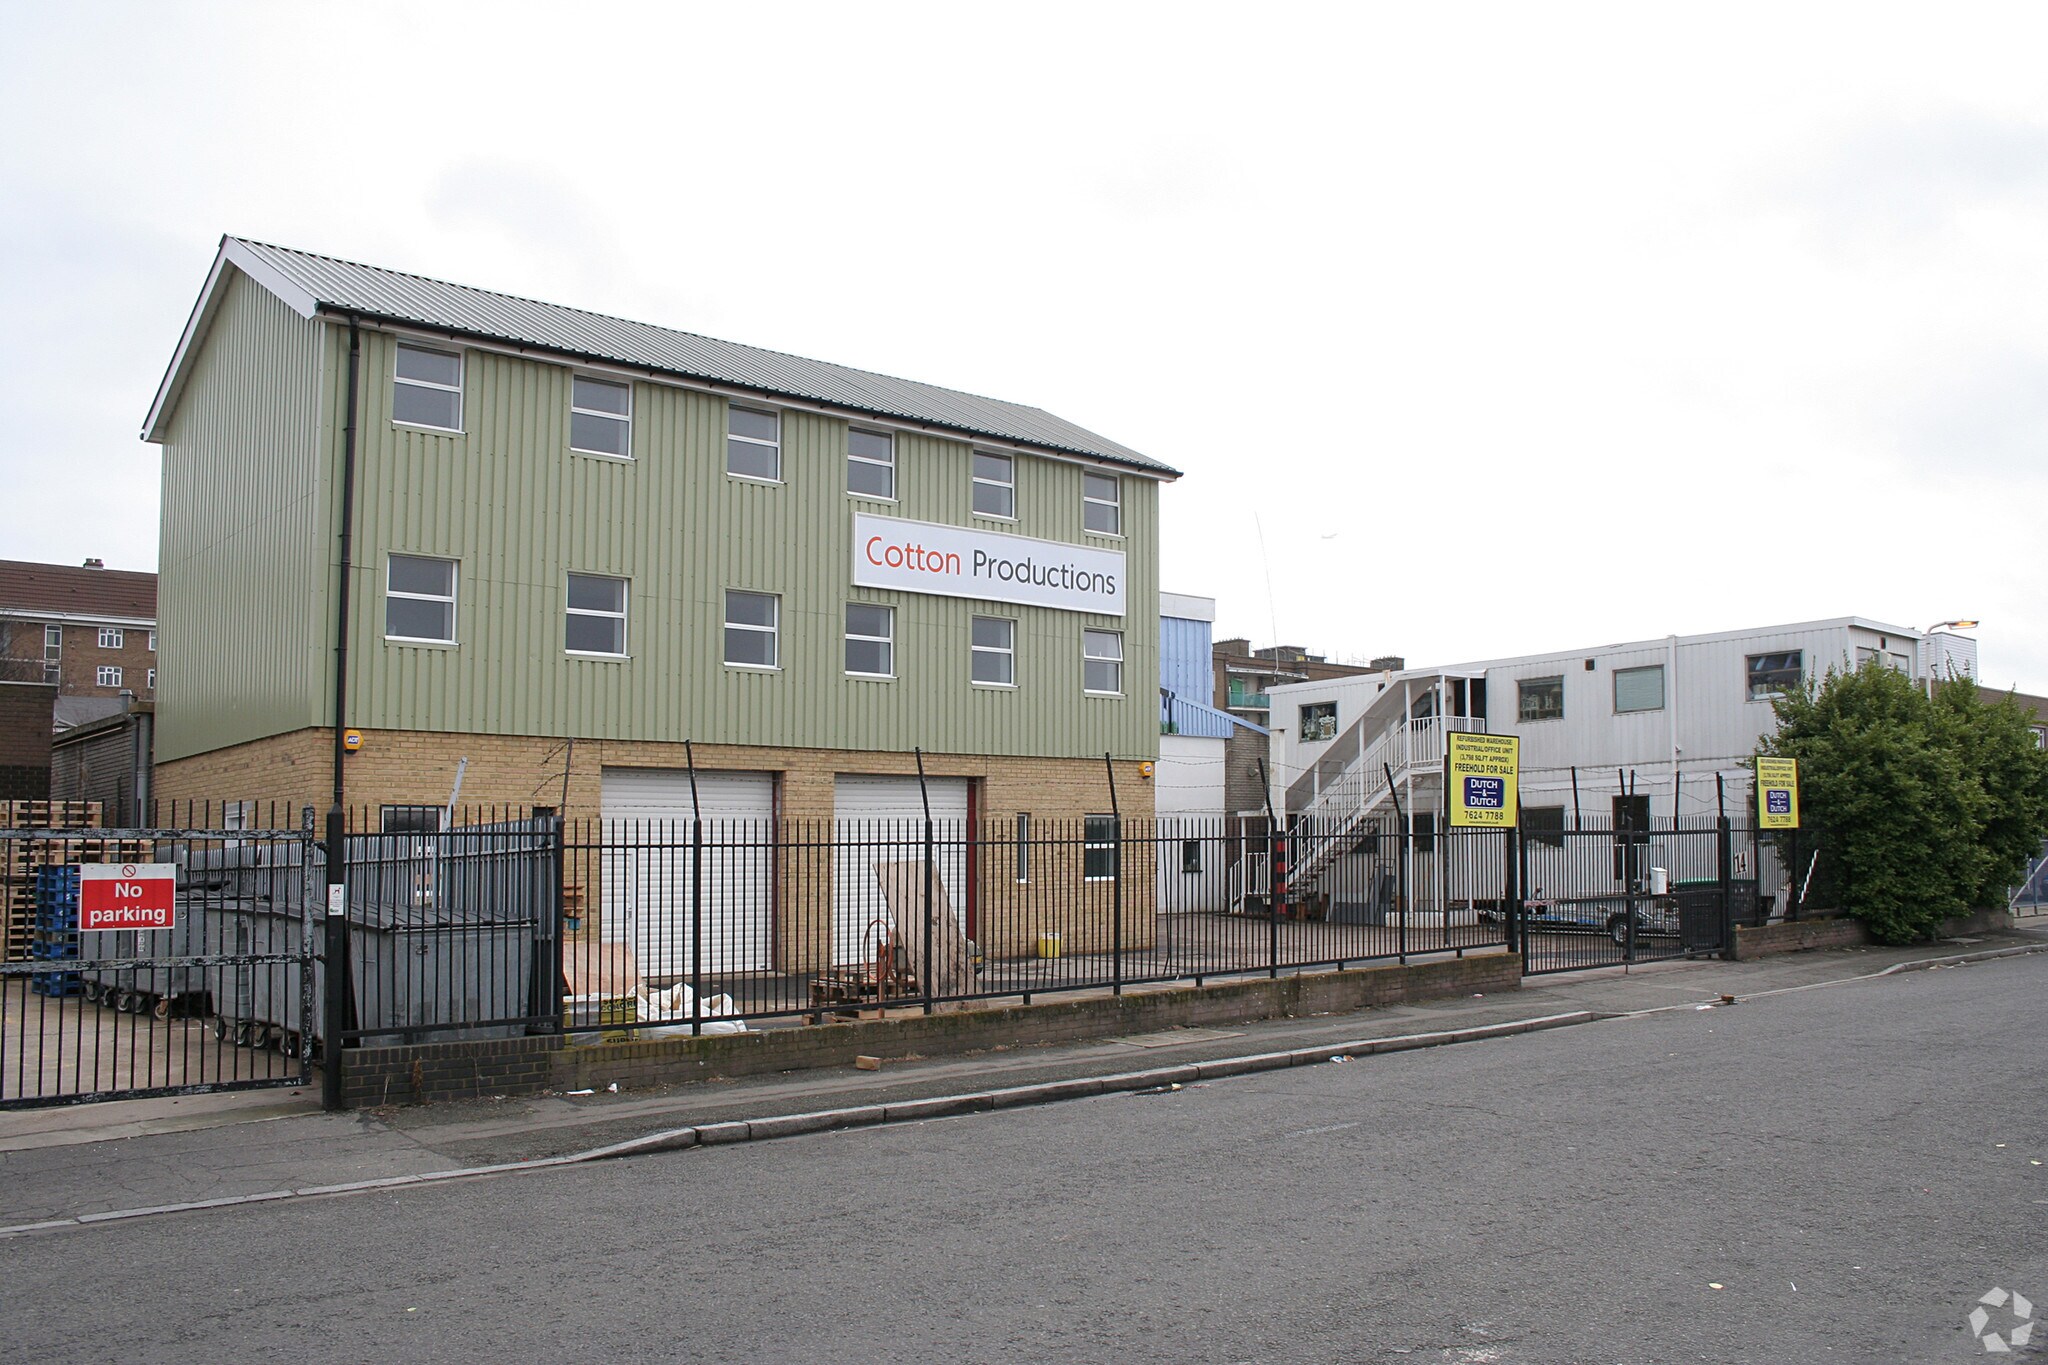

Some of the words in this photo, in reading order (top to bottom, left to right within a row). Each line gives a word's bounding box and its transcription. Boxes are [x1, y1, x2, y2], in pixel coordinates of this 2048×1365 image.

[866, 536, 961, 576] Cotton
[973, 549, 1116, 596] Productions
[1455, 763, 1486, 773] FREEHOLD
[1486, 765, 1499, 774] FOR
[1500, 766, 1514, 775] SALE
[1470, 779, 1498, 789] DUTCH
[1770, 791, 1787, 799] DUTCH
[1470, 796, 1498, 806] DUTCH
[1770, 804, 1788, 812] DUTCH
[1464, 811, 1483, 820] 7624
[1485, 812, 1504, 820] 7788
[1733, 853, 1746, 873] 14
[114, 882, 143, 898] No
[89, 905, 166, 927] parking
